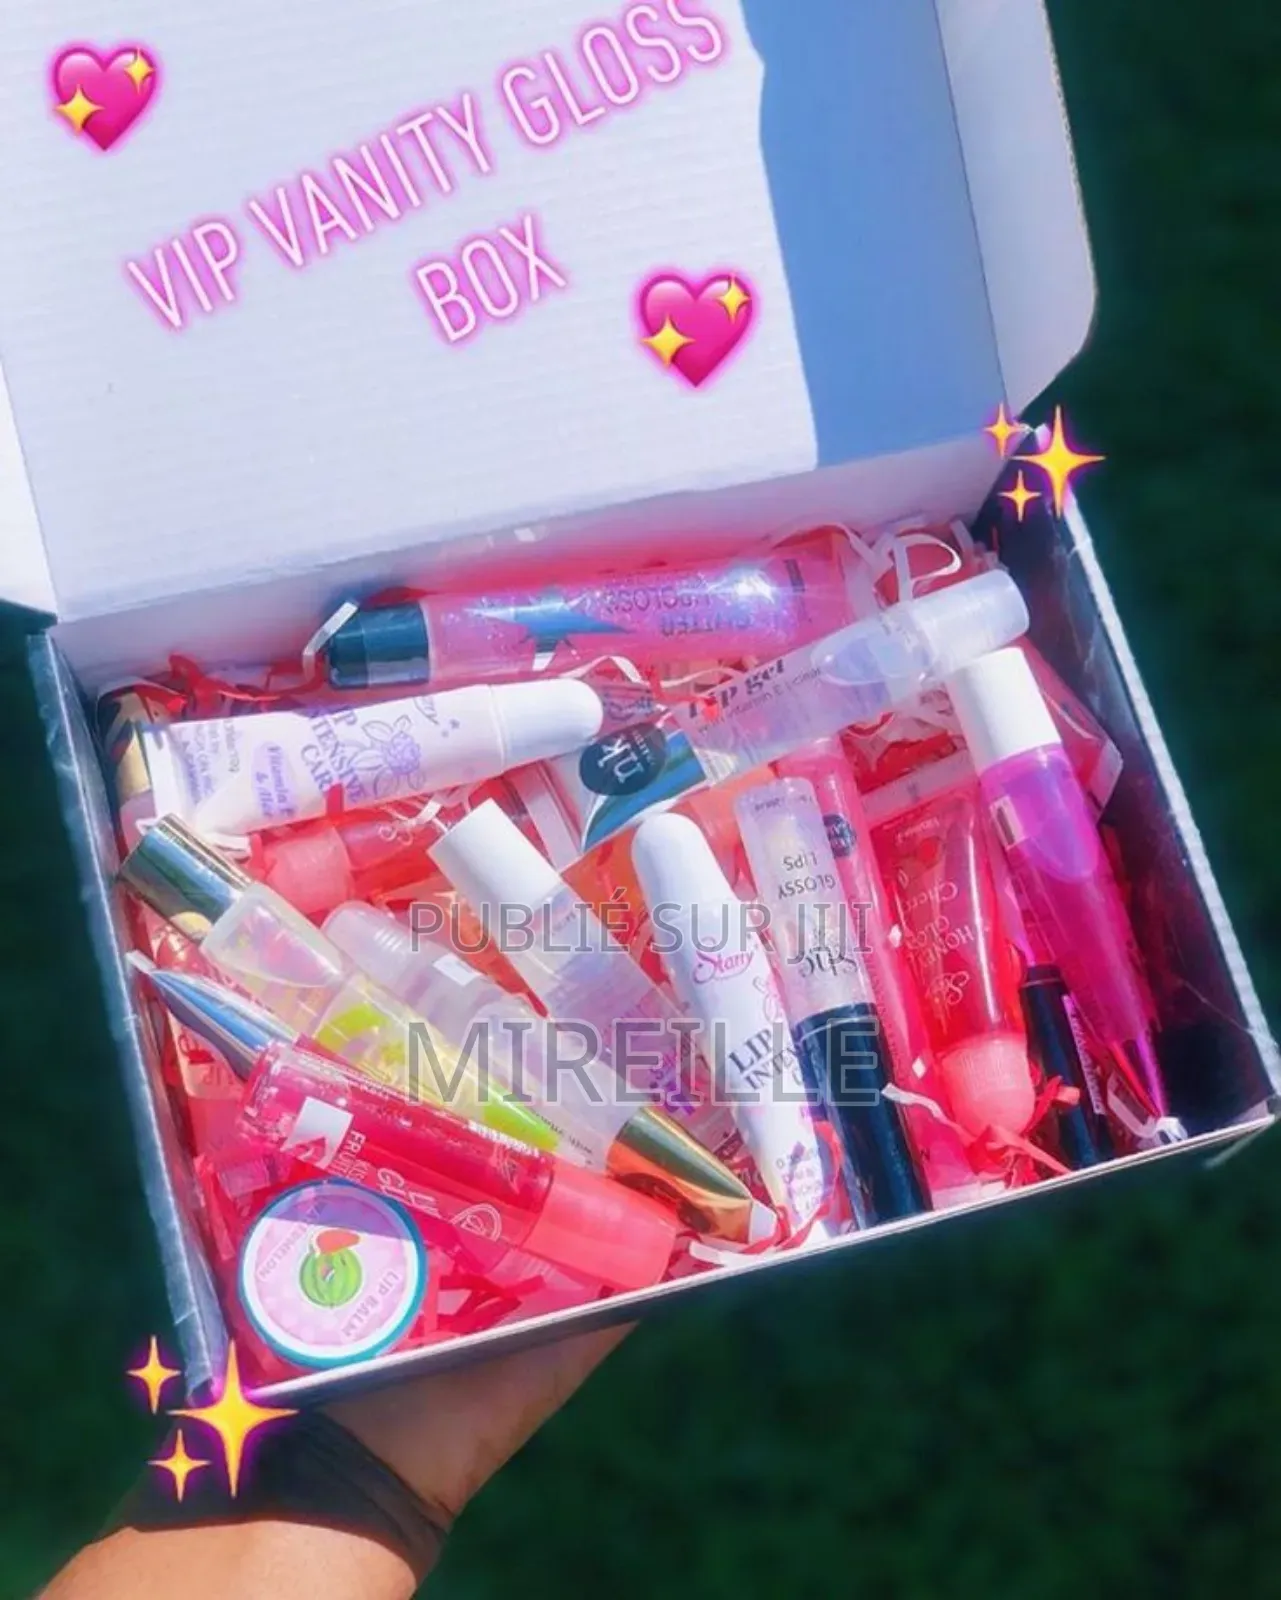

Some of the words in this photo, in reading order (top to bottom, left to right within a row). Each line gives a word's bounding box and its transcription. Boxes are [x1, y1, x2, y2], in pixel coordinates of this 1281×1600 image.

[301, 744, 336, 793] CAR
[782, 852, 818, 872] LIPS
[778, 873, 836, 900] GLOSSY
[728, 1028, 773, 1074] LIP
